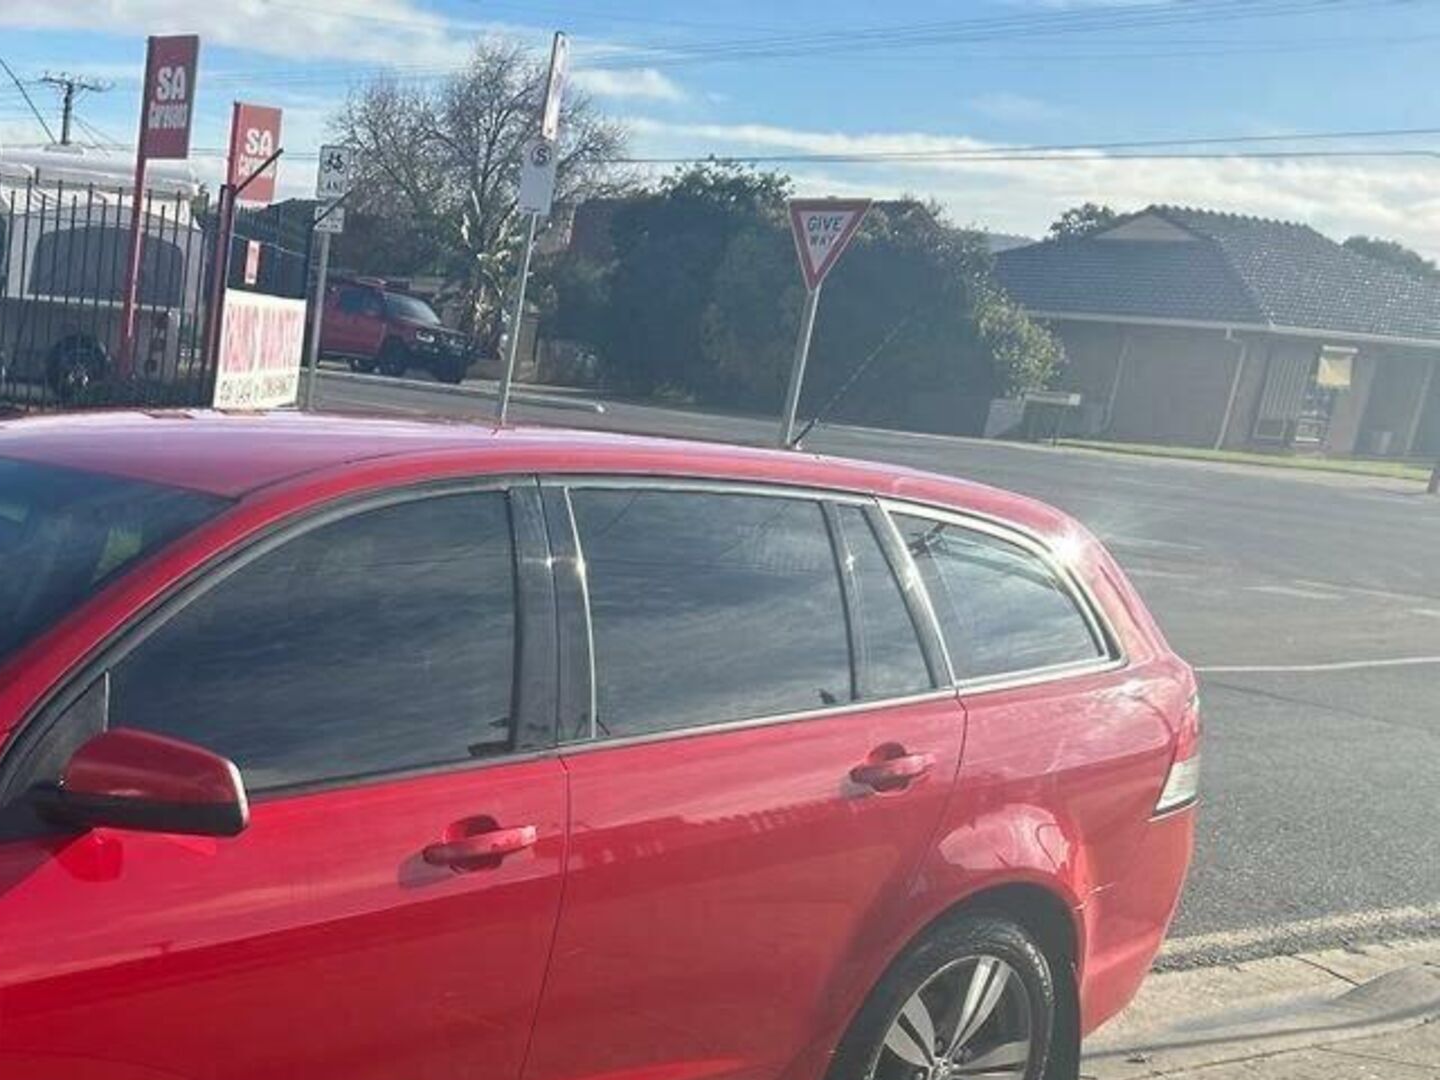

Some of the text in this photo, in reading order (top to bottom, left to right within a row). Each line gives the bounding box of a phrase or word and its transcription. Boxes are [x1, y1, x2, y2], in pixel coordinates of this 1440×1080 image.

[157, 66, 186, 101] SA
[245, 128, 273, 156] SA
[807, 215, 843, 232] GIVE
